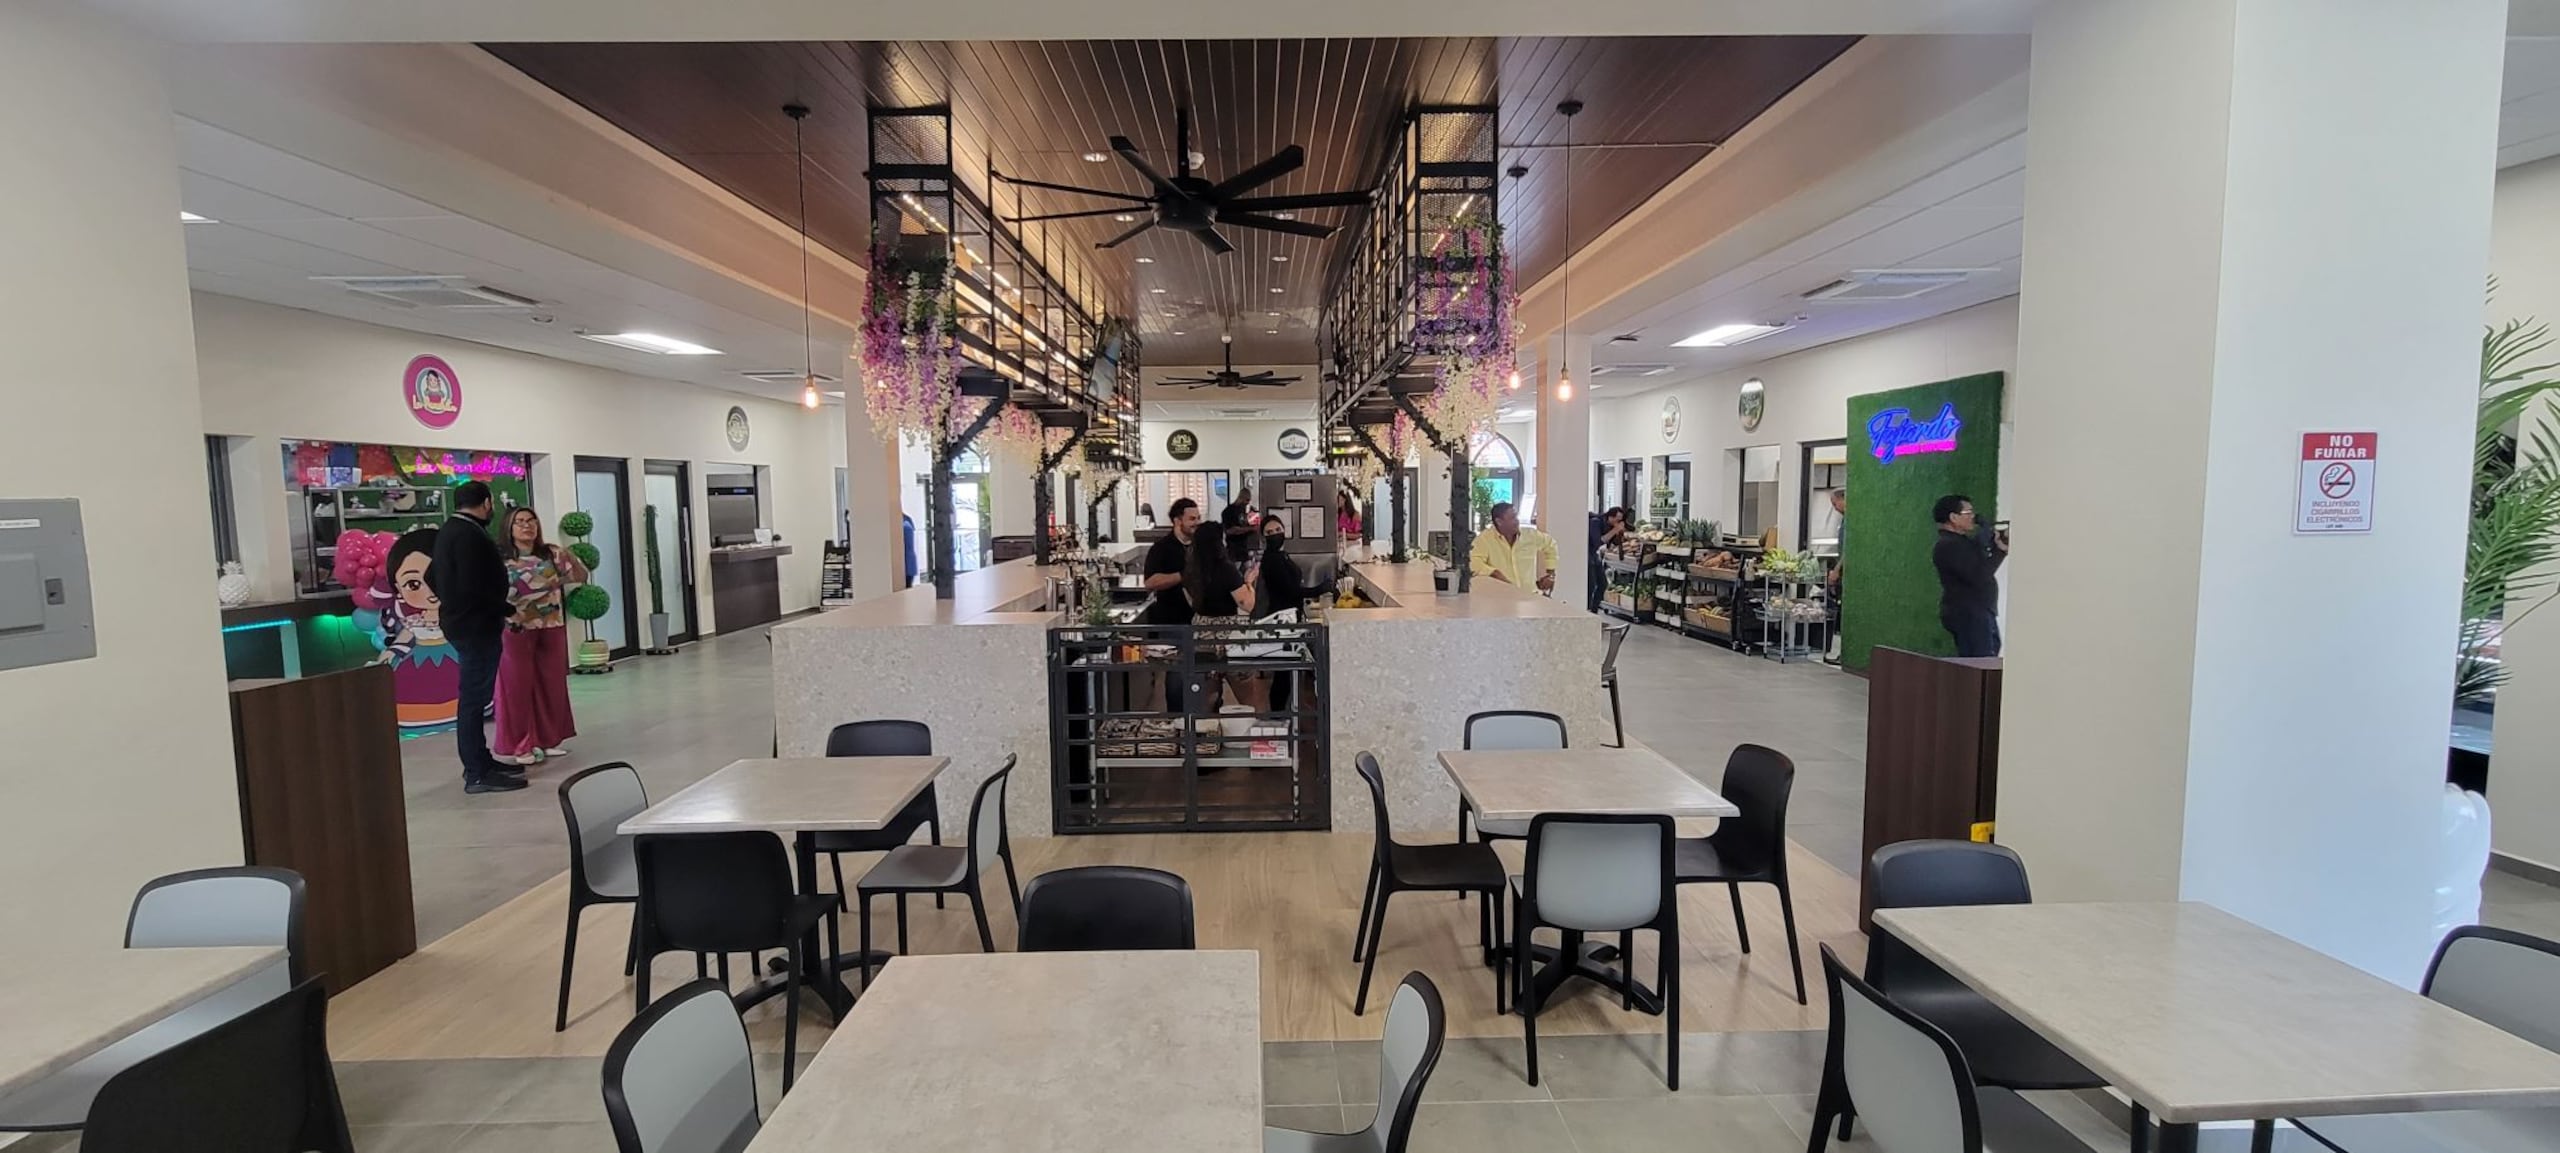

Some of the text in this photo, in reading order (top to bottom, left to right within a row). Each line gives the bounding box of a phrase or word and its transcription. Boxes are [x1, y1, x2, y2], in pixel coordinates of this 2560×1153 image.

[1866, 402, 1961, 464] Fajardo
[2330, 435, 2353, 447] NO
[2315, 448, 2367, 458] FUMAR
